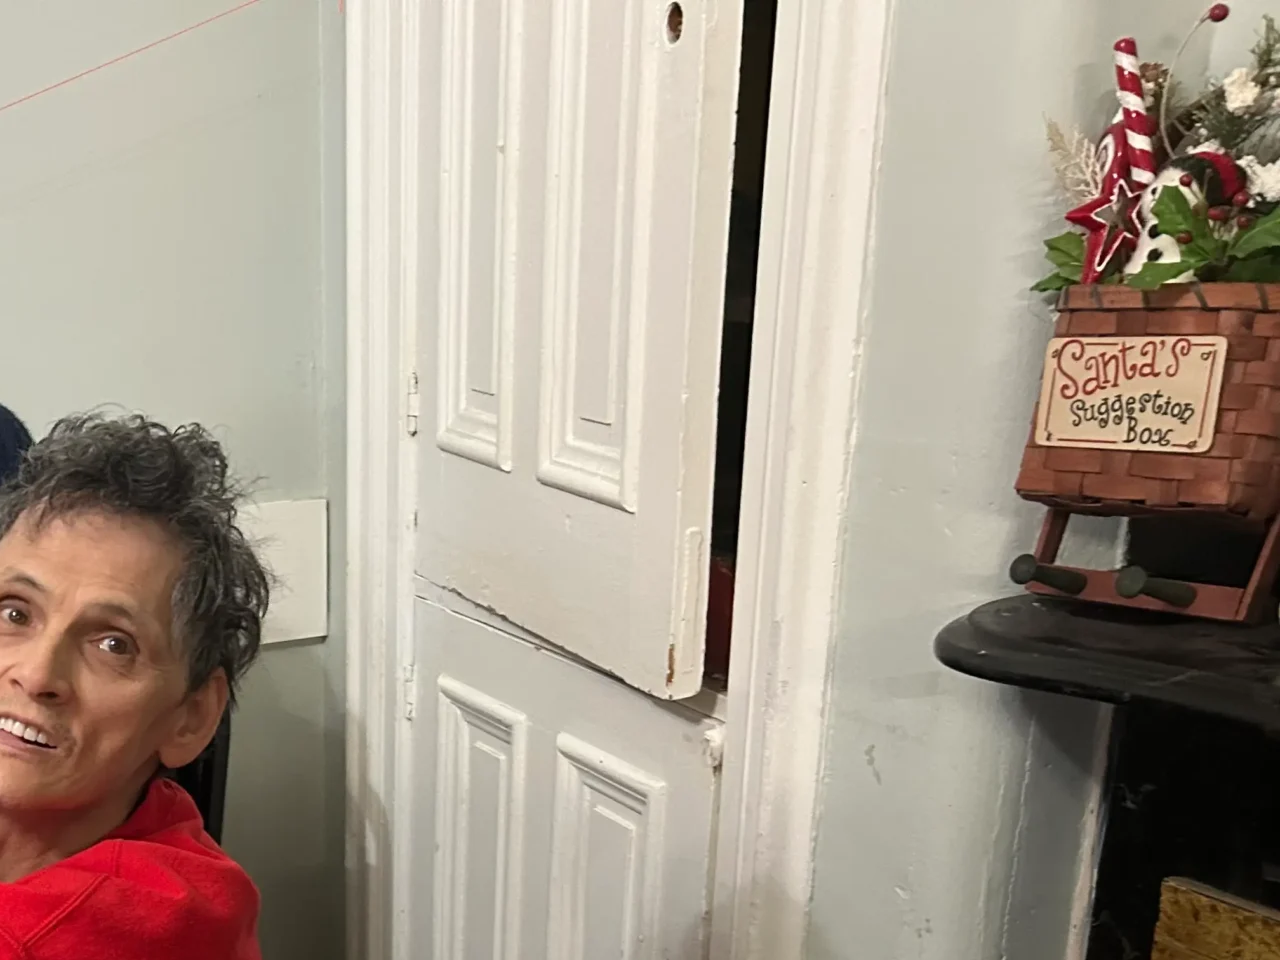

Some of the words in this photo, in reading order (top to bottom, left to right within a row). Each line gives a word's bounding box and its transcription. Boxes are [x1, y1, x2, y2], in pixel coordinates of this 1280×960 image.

[1056, 337, 1191, 400] Santa's
[1070, 389, 1195, 428] Suggestion
[1122, 416, 1174, 447] Box
